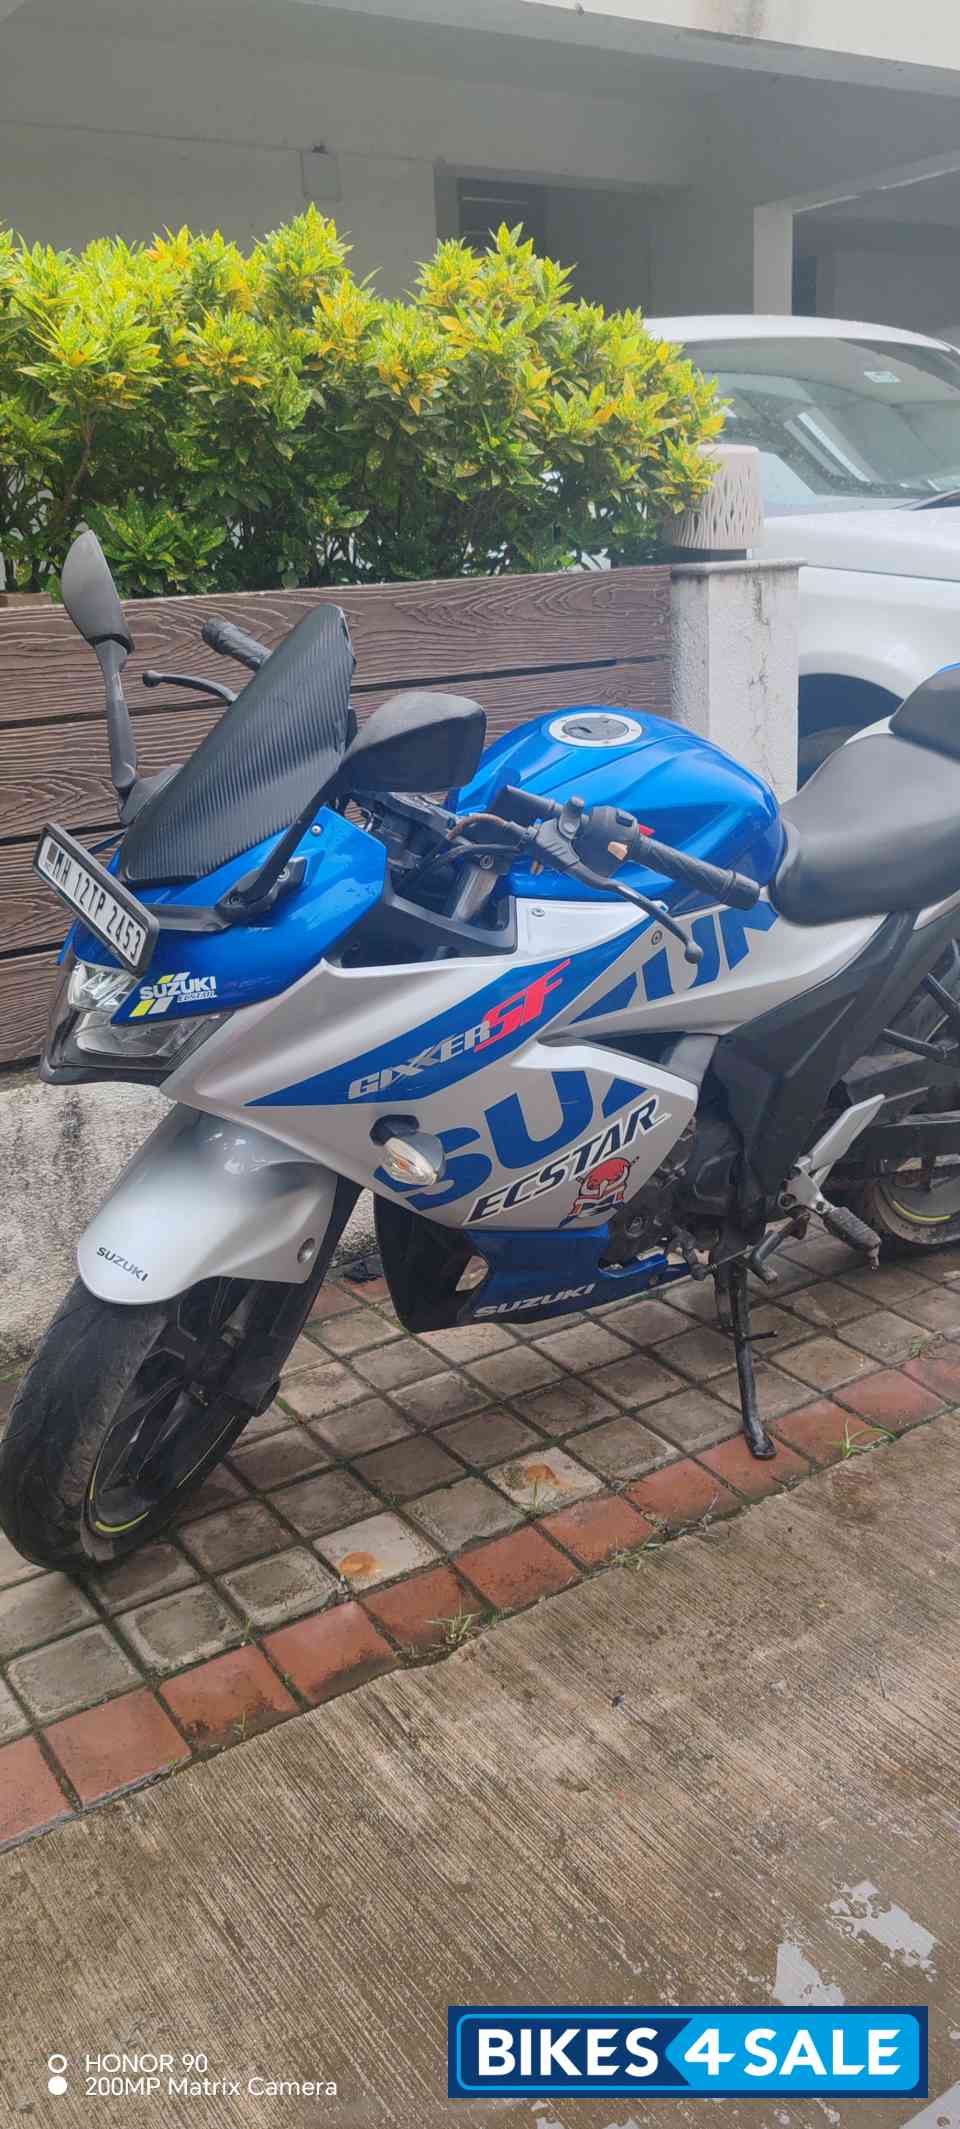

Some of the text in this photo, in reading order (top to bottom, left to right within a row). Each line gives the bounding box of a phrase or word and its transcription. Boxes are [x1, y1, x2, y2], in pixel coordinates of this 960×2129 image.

[53, 848, 72, 887] MH
[106, 905, 142, 960] 2453
[139, 976, 217, 1000] SUZUKI
[475, 958, 571, 1052] SF
[464, 1095, 672, 1226] ECSTAR
[97, 1247, 148, 1282] SUZUKI
[473, 1283, 595, 1318] SUZUKI
